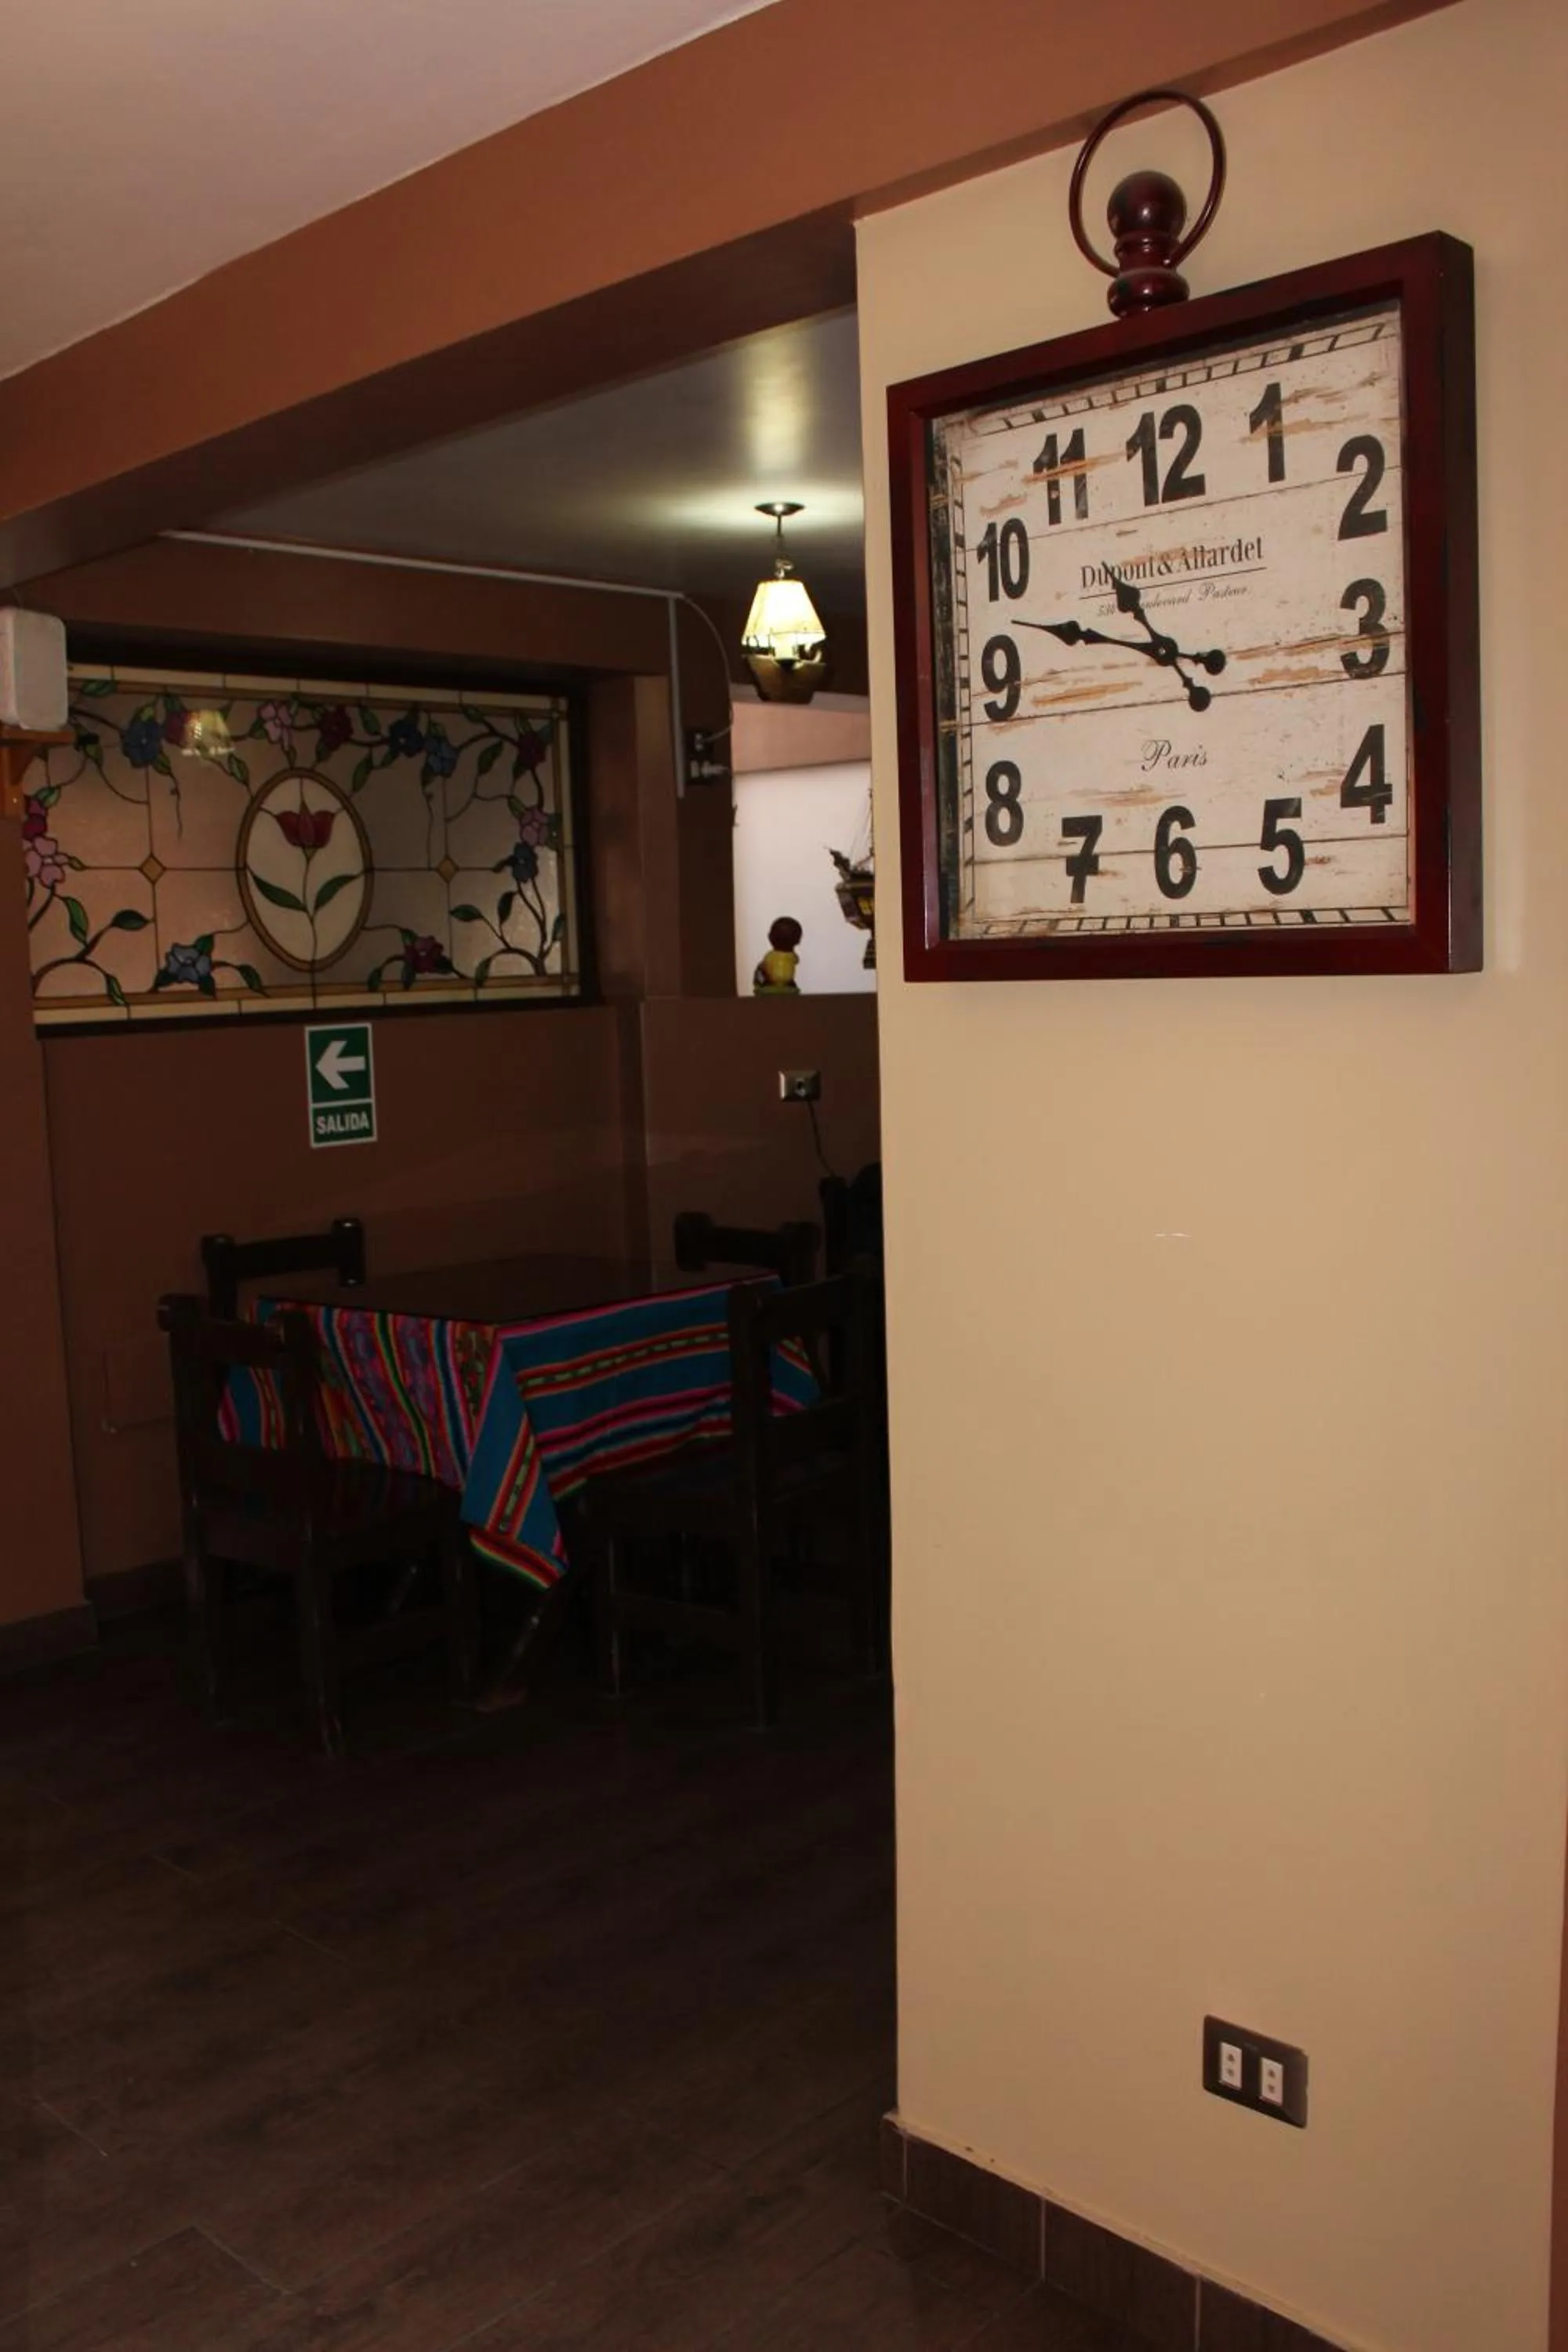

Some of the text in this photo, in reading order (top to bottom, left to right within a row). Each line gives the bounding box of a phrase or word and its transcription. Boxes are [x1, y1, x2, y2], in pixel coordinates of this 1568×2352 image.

[1033, 428, 1088, 525] 11
[1126, 404, 1207, 506] 12
[1249, 382, 1287, 483] 1
[1336, 434, 1388, 540] 2
[977, 517, 1029, 602] 10
[1339, 578, 1391, 680] 3
[981, 634, 1021, 721] 9
[1141, 739, 1207, 771] Paris
[1340, 724, 1393, 824] 4
[985, 760, 1024, 847] 8
[1258, 797, 1305, 895] 5
[1061, 815, 1102, 903] 7
[1154, 805, 1196, 899] 6
[316, 1110, 370, 1135] SALIDA
